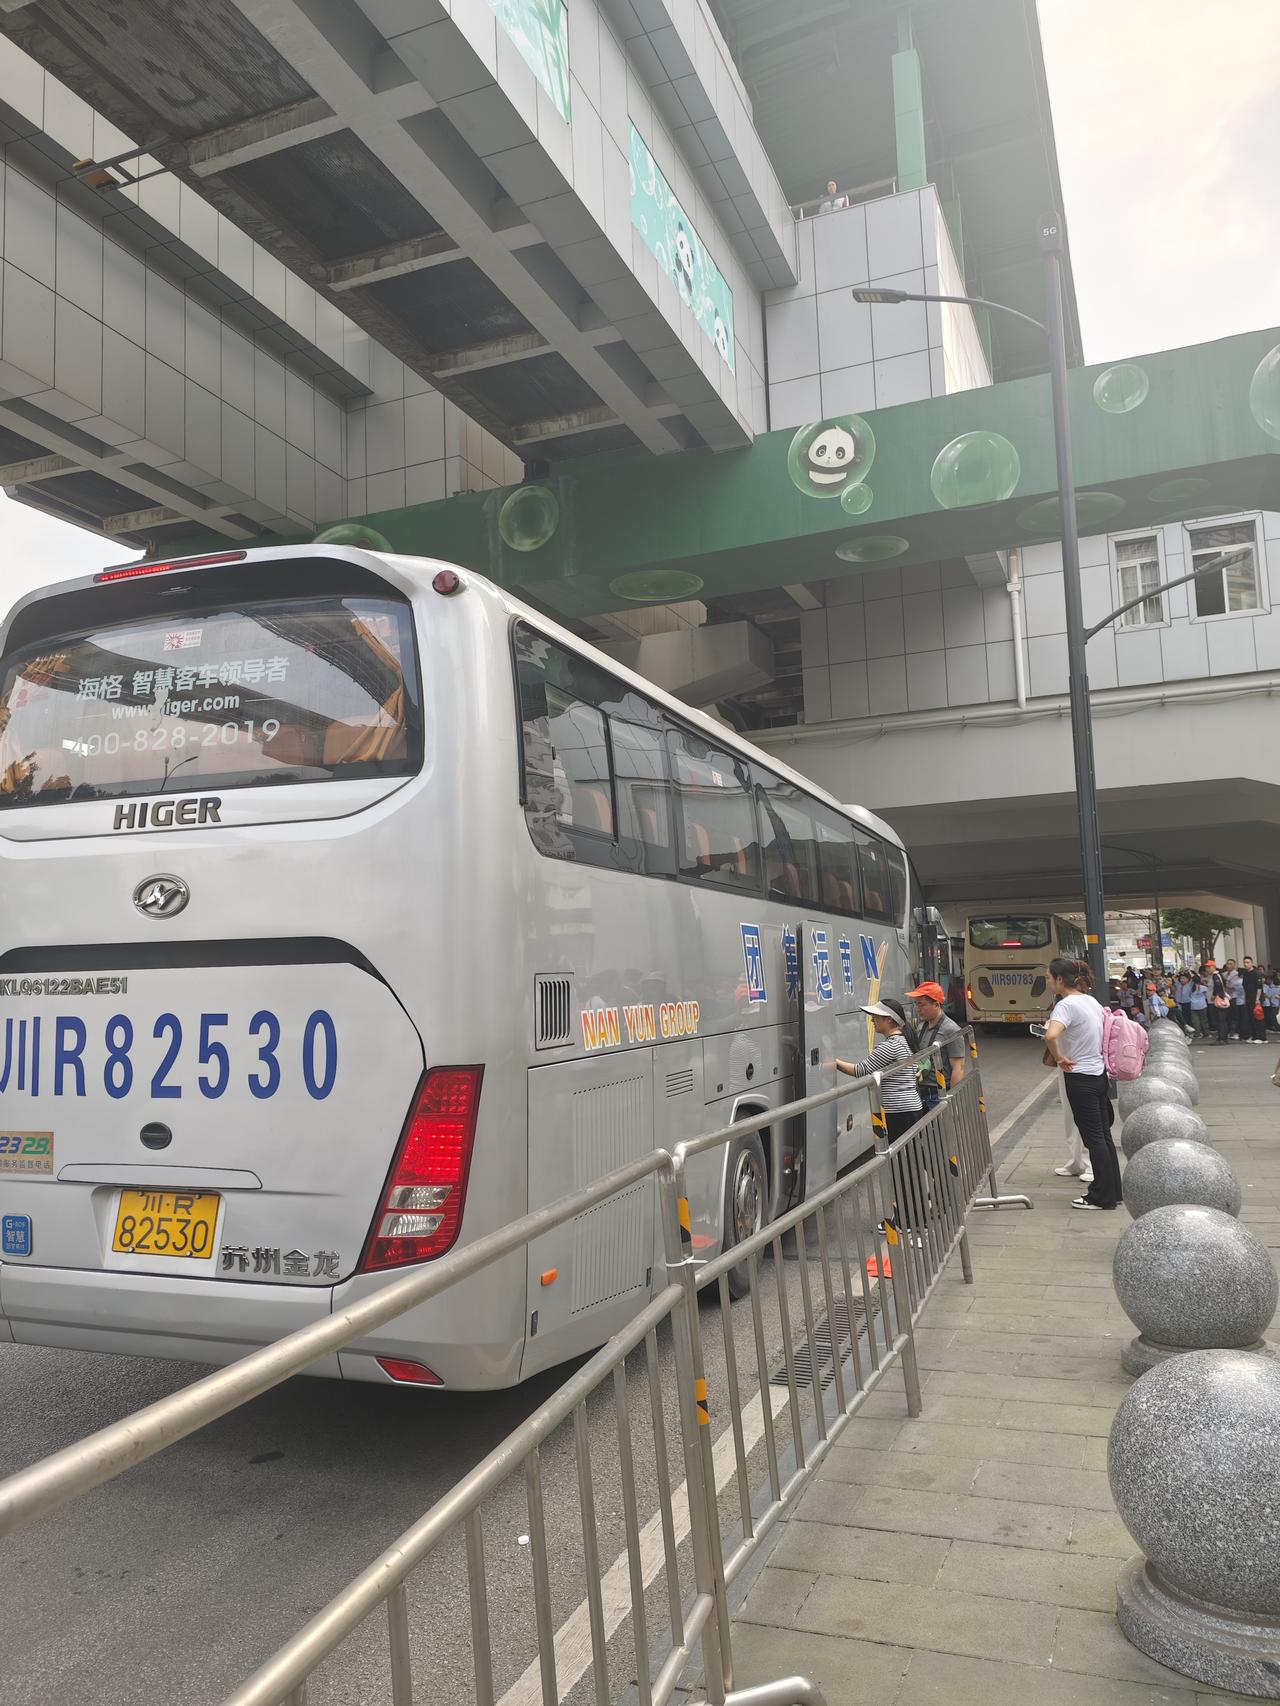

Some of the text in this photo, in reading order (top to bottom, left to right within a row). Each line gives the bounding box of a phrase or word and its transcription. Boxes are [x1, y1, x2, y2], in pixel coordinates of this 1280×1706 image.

[1043, 226, 1057, 236] 5G
[77, 656, 289, 701] 海格 智慧客车领导者
[70, 718, 281, 757] 400-828-2019
[113, 797, 222, 830] HIGER
[0, 976, 128, 996] KLQ6122BAE51
[991, 973, 1034, 986] 川R90783
[581, 1000, 700, 1051] NAN YUN GROUP
[0, 1009, 338, 1100] 川R82530
[119, 1215, 209, 1253] 82530
[221, 1244, 340, 1279] 苏州金龙
